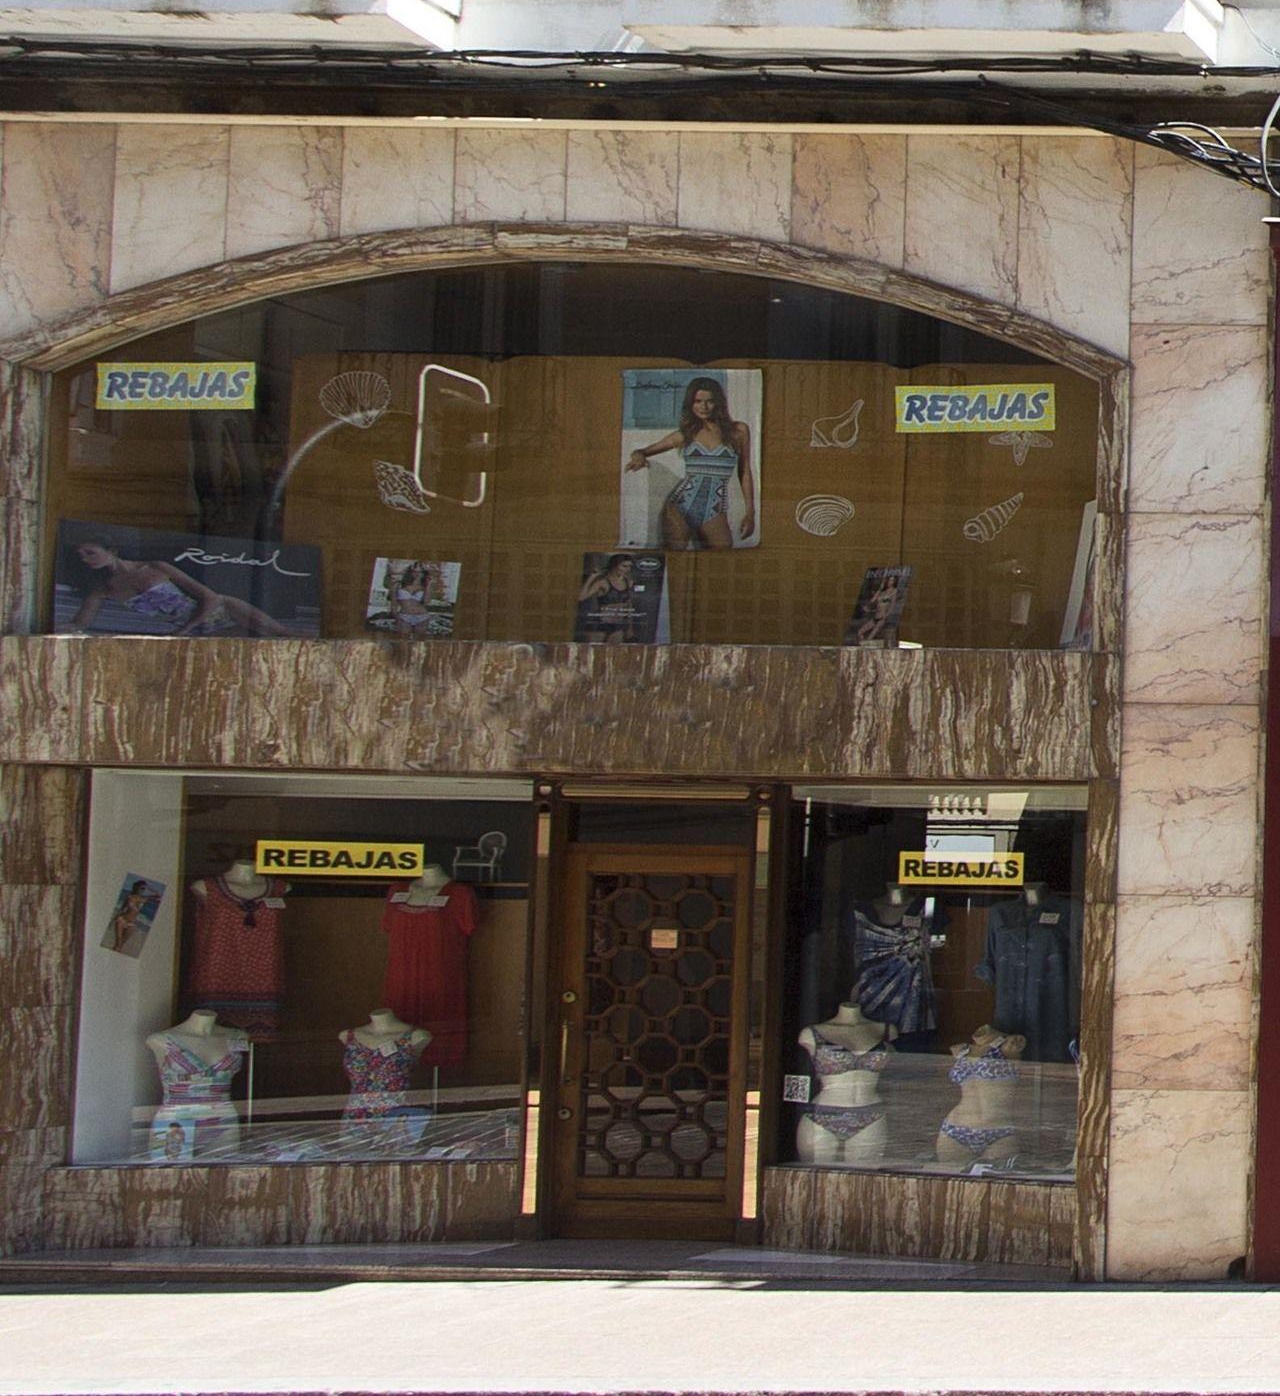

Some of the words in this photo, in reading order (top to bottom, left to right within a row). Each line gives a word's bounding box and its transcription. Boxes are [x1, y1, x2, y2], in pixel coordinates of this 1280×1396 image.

[105, 370, 249, 400] REBAJAS
[904, 392, 1050, 423] REBAJAS
[263, 848, 419, 870] REBAJAS
[904, 859, 1020, 879] REBAJAS
